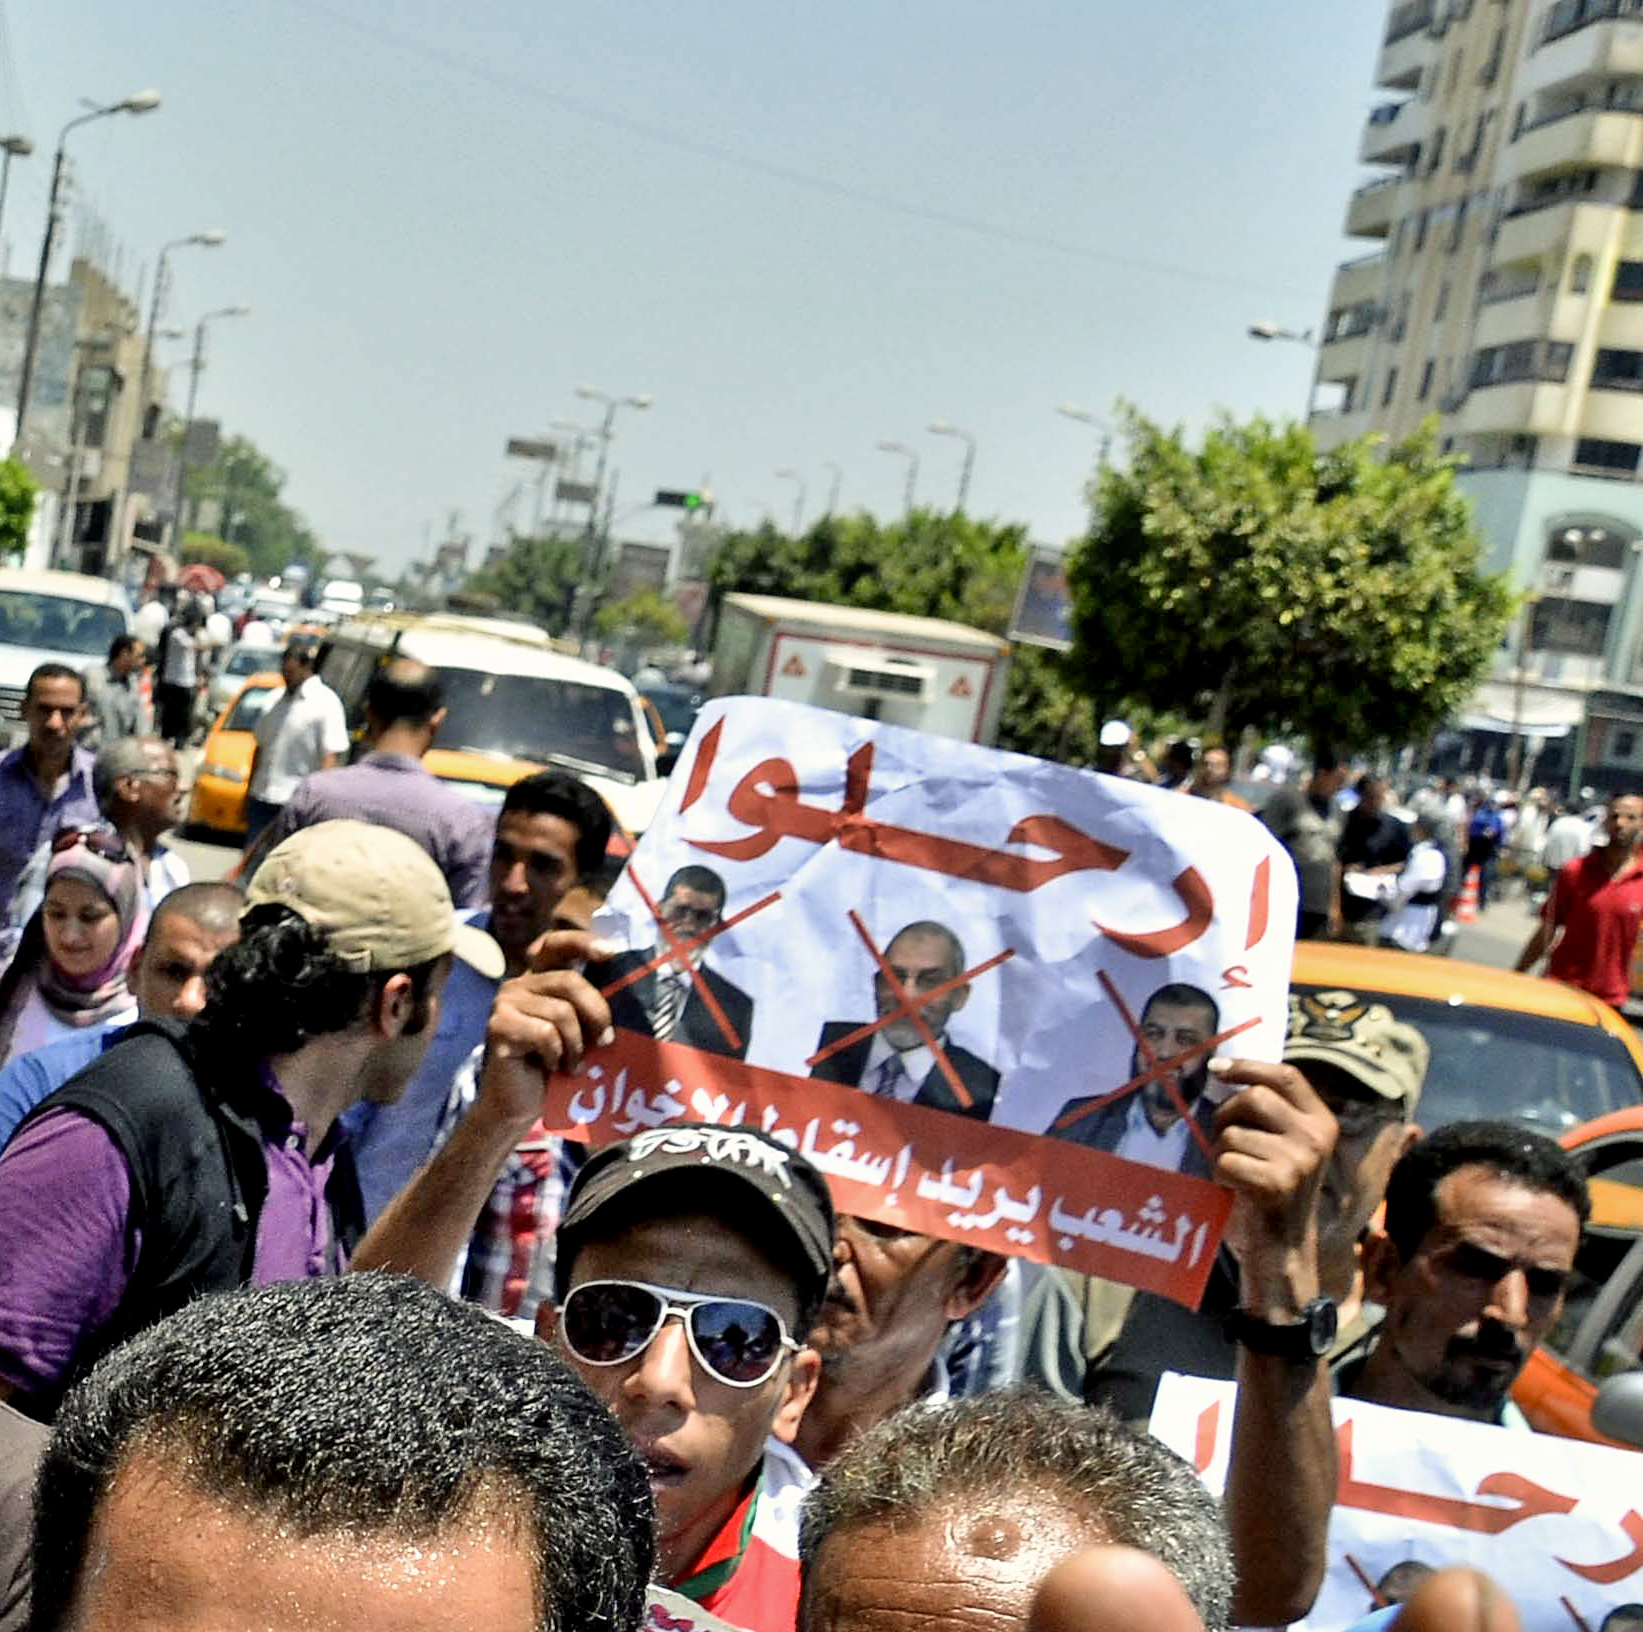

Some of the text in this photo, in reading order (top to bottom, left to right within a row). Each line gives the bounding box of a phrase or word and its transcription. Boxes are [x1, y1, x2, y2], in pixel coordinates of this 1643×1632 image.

[680, 714, 1271, 990] إرحلوا
[917, 1158, 1043, 1246] يريد
[1048, 1195, 1209, 1269] الشعب
